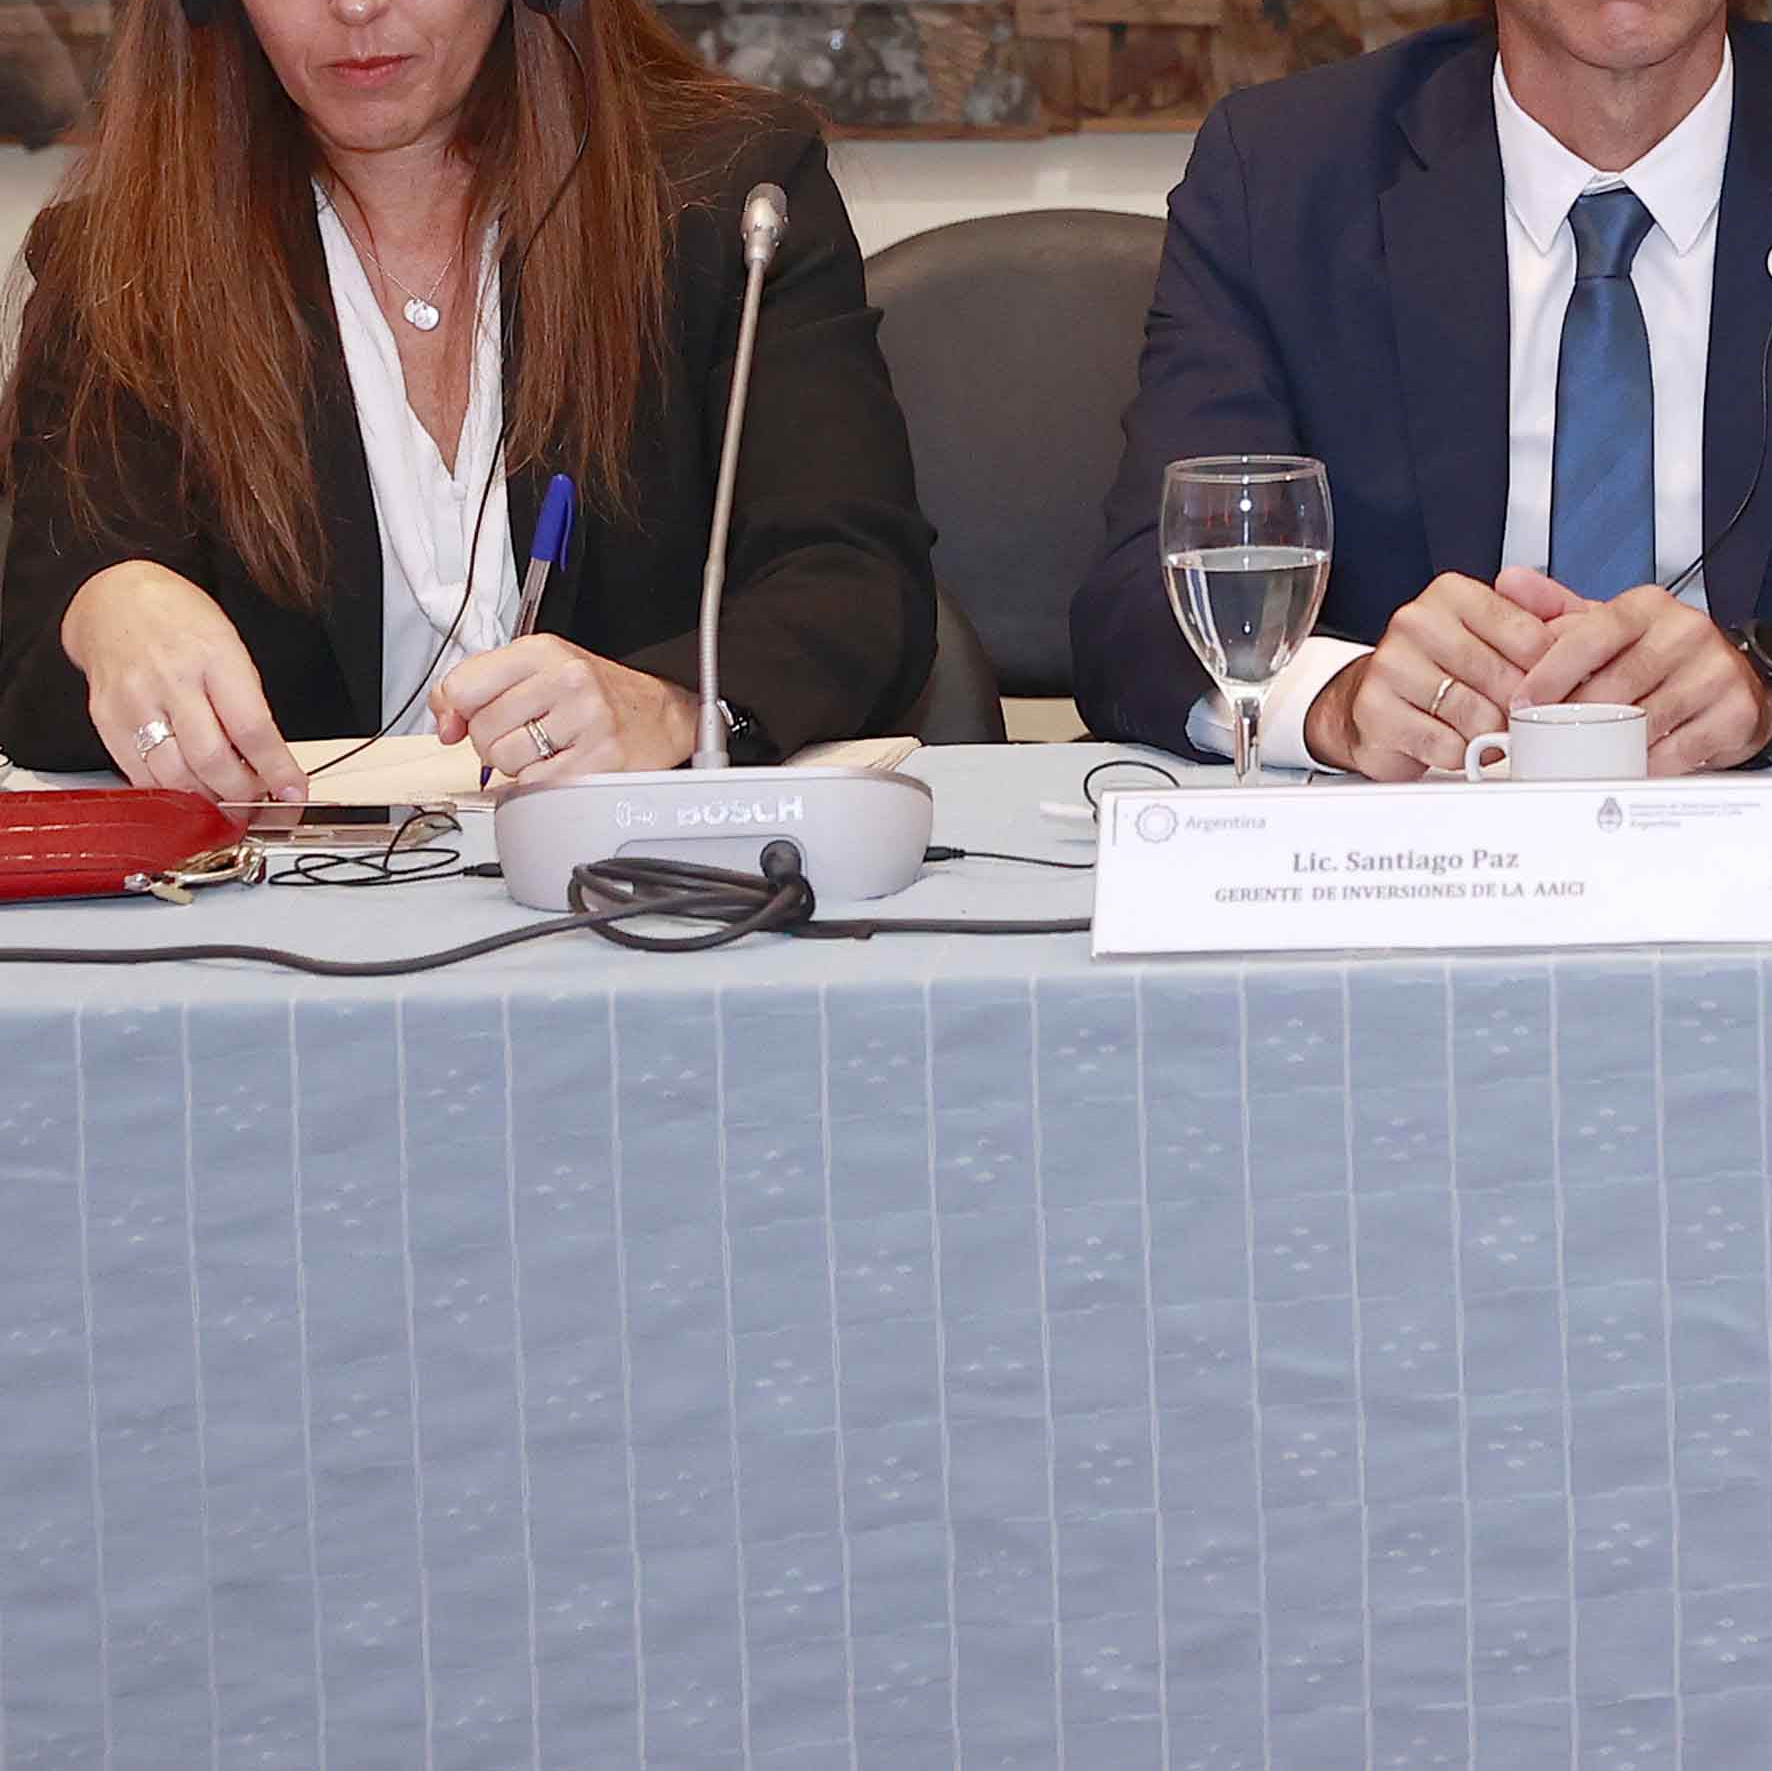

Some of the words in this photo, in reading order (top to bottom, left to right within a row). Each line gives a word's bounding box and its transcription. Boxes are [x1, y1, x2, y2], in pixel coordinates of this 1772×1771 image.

[1185, 815, 1267, 833] Argentina
[1292, 852, 1338, 873] Lic.
[1345, 850, 1464, 876] Santiago
[1472, 848, 1519, 869] Paz
[1214, 886, 1303, 903] GERENTE
[1311, 885, 1337, 901] DE
[1342, 883, 1467, 901] INVERSIONES
[1471, 883, 1497, 898] DE
[1501, 882, 1525, 898] LA
[1534, 881, 1585, 897] AAICI
